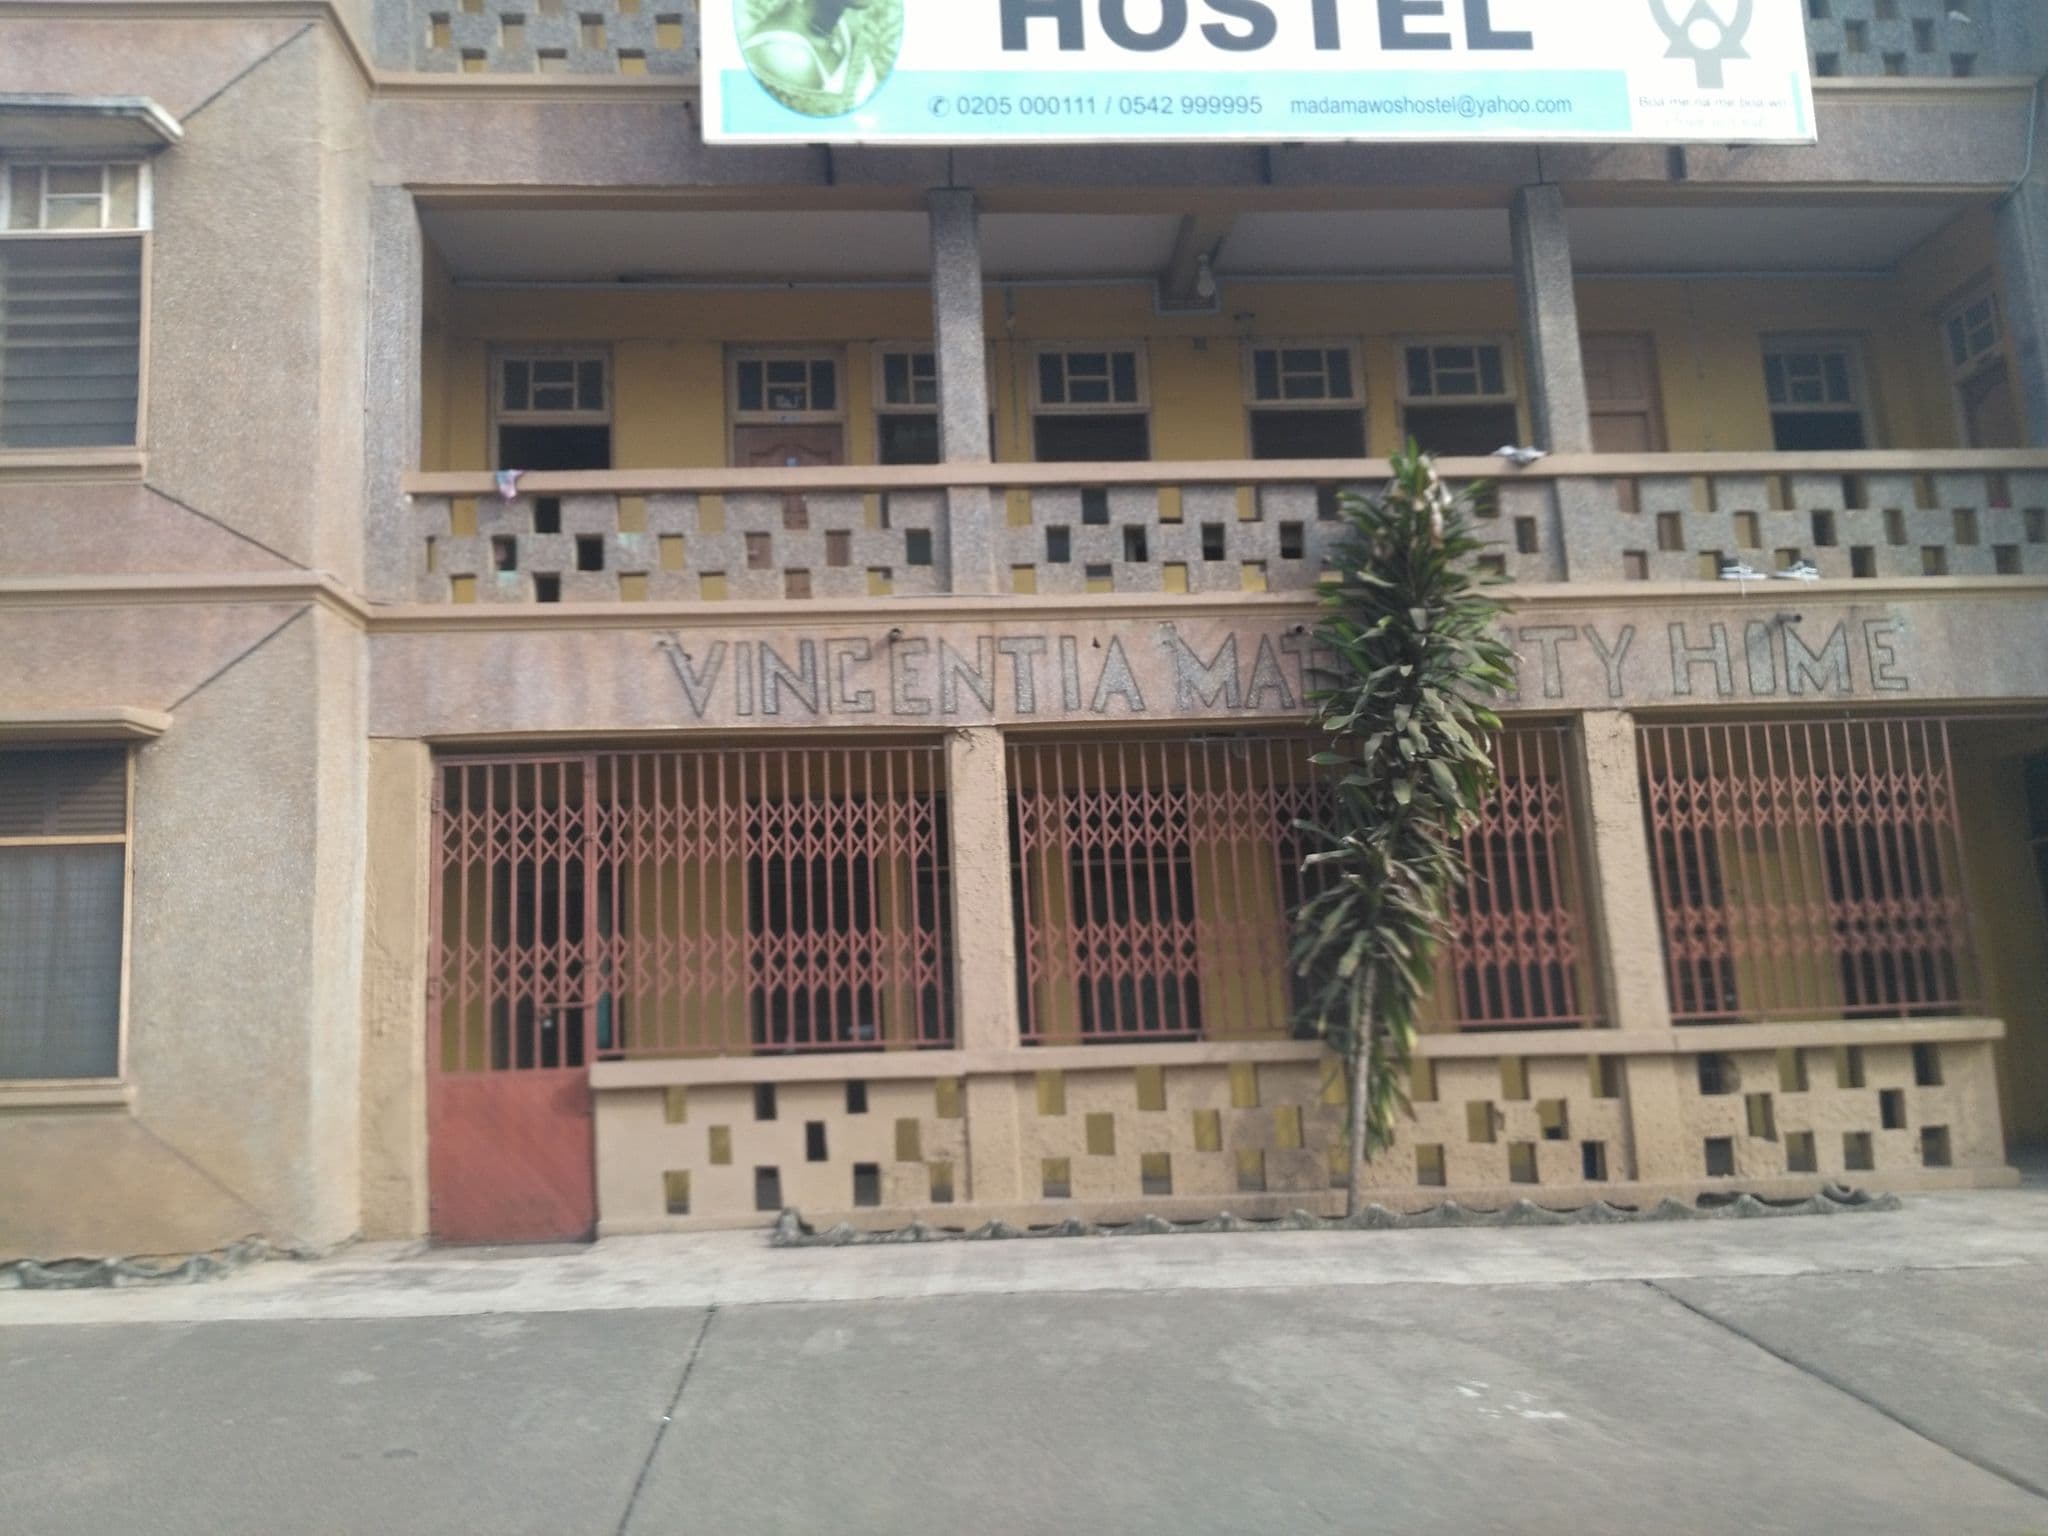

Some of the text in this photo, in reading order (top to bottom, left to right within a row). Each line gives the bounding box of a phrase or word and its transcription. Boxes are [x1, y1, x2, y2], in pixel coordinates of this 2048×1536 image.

[1000, 0, 1534, 52] HOSTEL
[957, 96, 1263, 115] 0205 000111 / 0542 999995
[664, 632, 1146, 718] VINCENTIA
